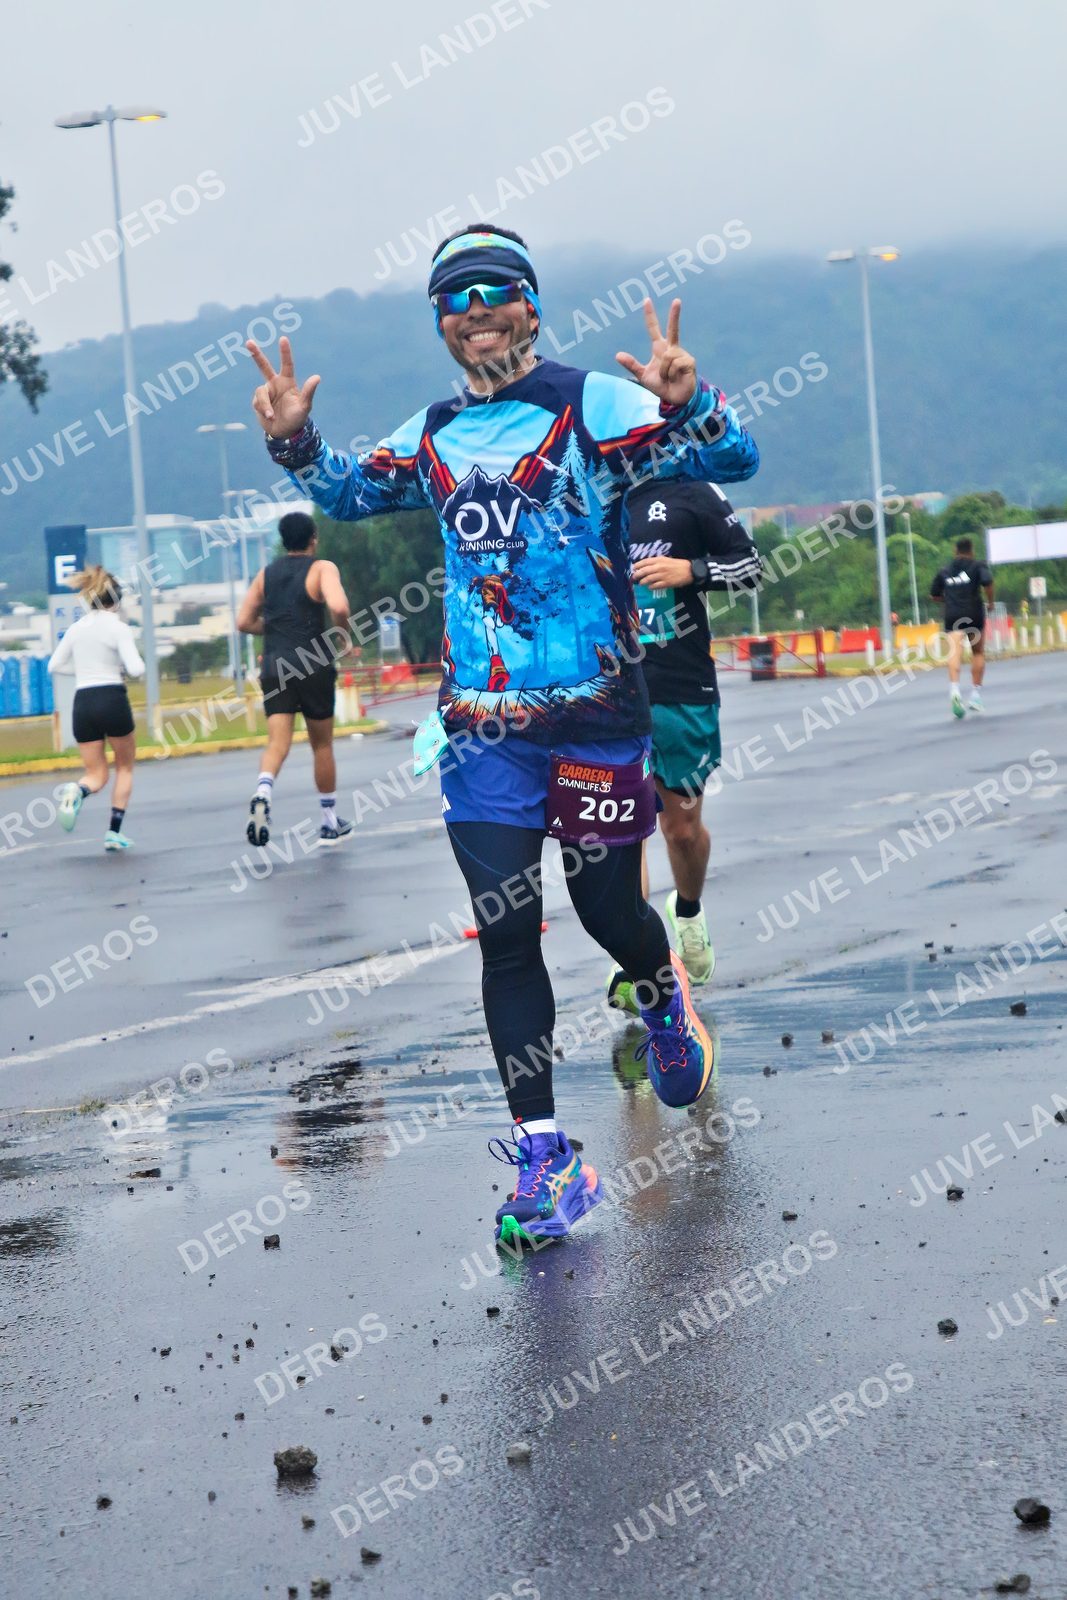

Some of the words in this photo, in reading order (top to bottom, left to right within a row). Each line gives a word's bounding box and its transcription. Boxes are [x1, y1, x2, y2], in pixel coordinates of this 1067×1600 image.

[455, 497, 521, 542] OV
[506, 540, 525, 549] CLUB
[55, 554, 77, 586] E
[559, 763, 614, 783] CARRERA
[579, 796, 636, 823] 202
